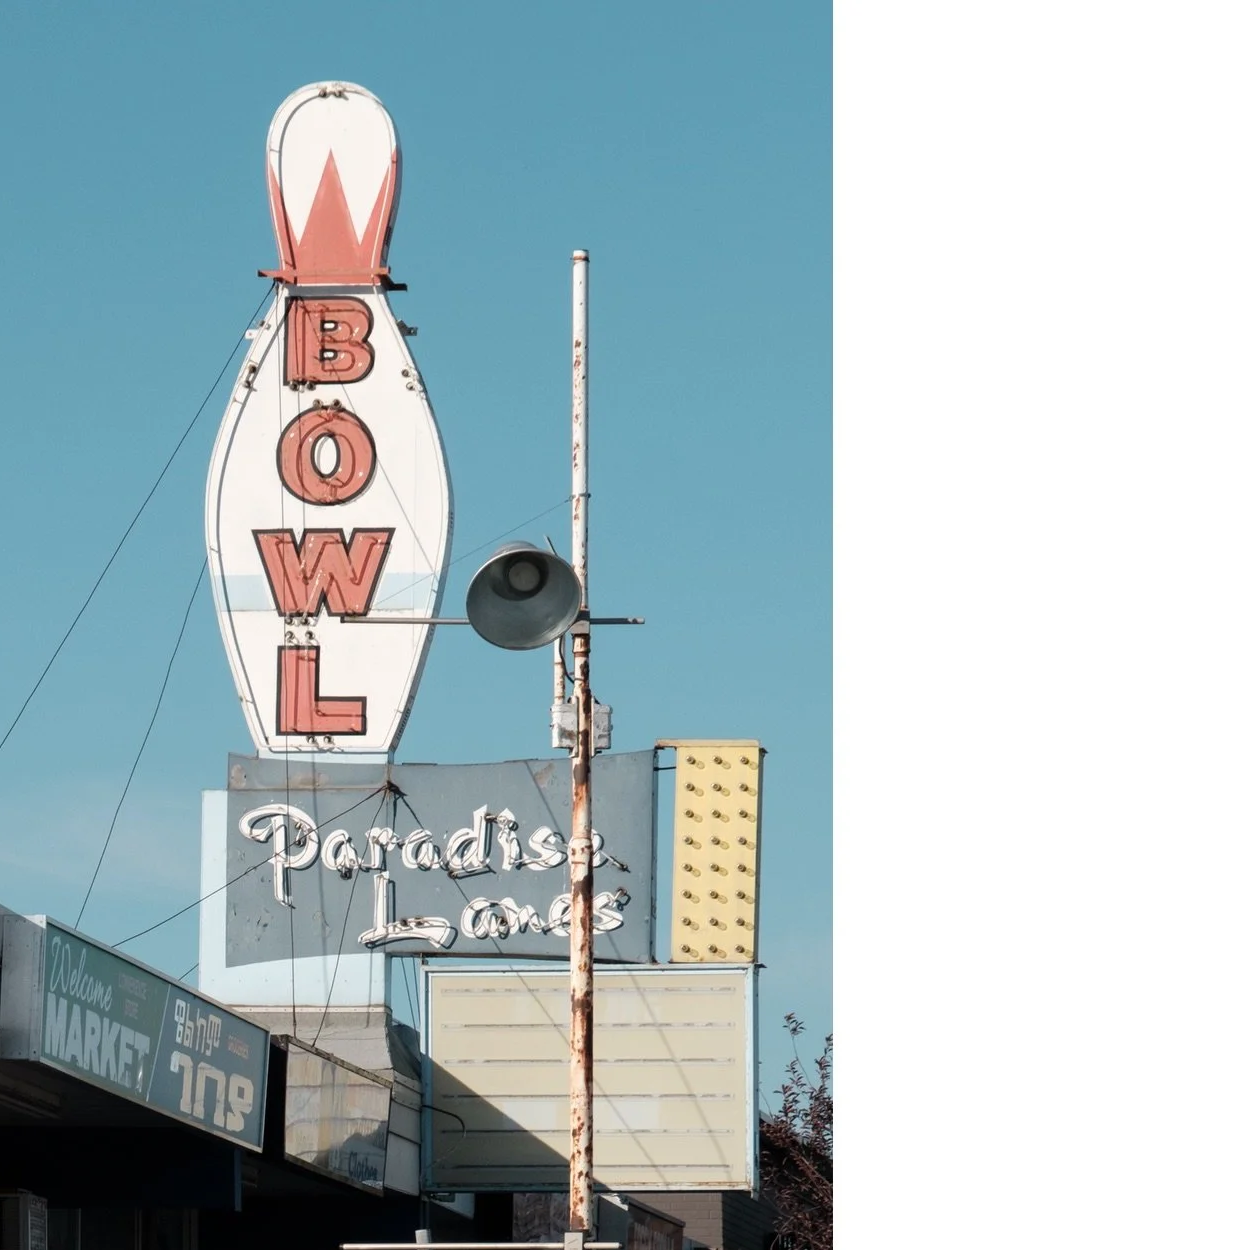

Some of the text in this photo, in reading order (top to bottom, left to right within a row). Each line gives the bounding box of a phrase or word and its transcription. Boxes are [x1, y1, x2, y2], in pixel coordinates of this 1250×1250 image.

[251, 295, 396, 736] BOWL
[50, 936, 112, 1012] Welcome
[45, 992, 150, 1092] MARKET
